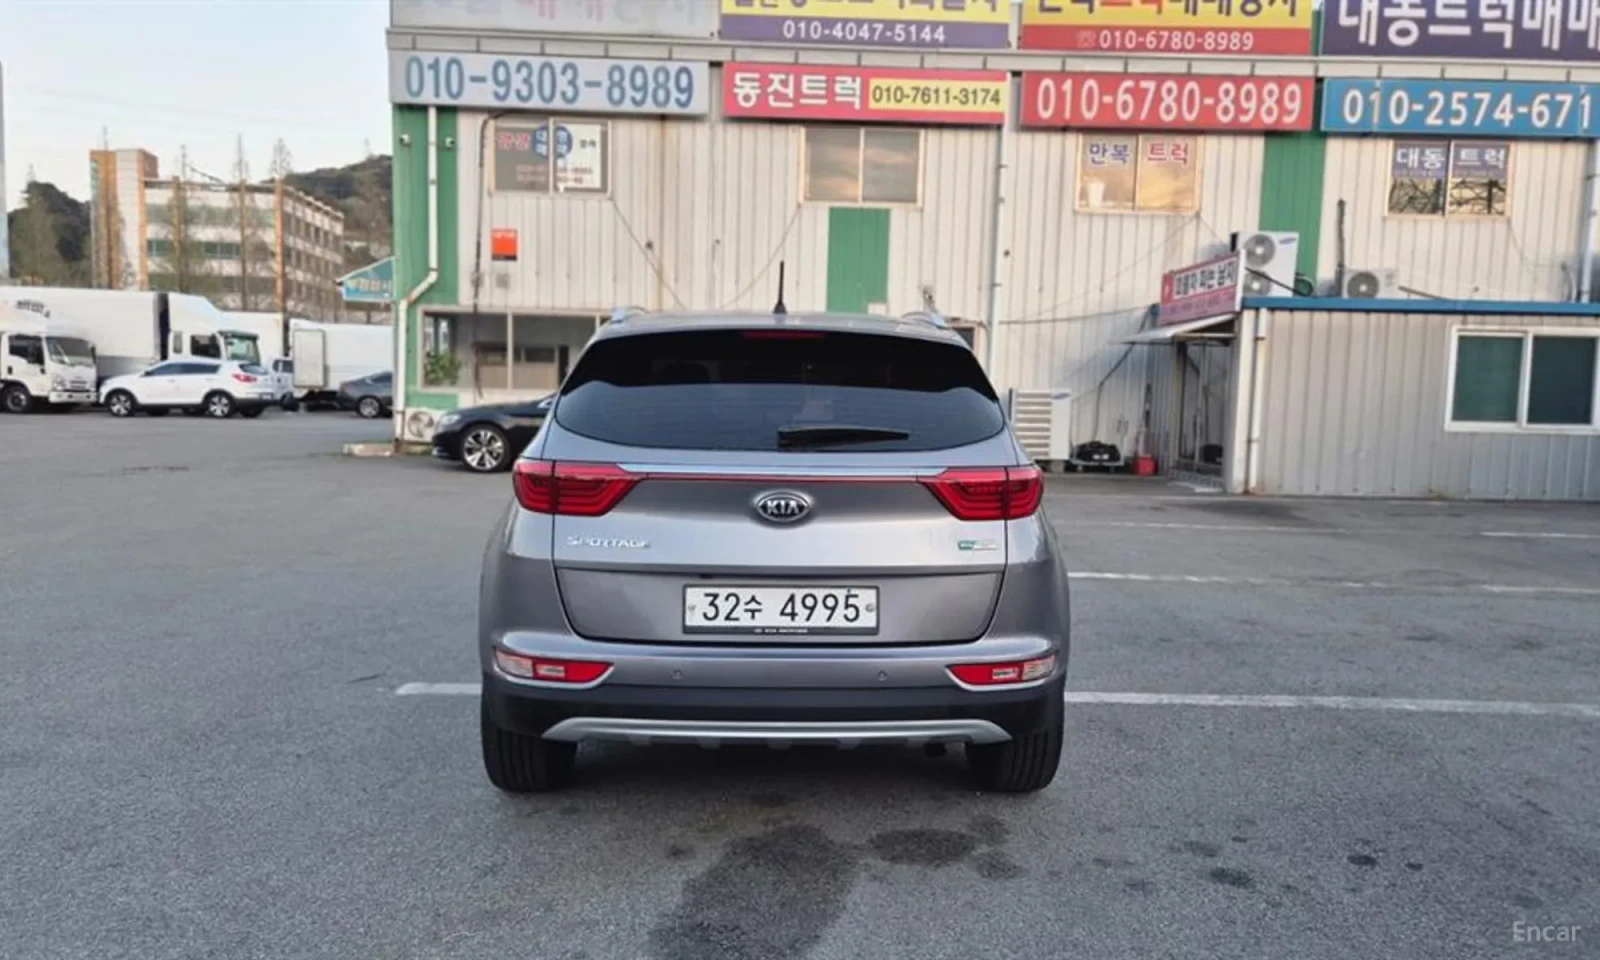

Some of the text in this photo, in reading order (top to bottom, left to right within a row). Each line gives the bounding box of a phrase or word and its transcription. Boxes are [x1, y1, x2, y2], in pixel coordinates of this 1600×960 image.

[783, 19, 946, 43] 010-4047-5144
[1099, 29, 1254, 50] 010-6780-8989
[404, 55, 695, 109] 010-9303-8989
[733, 71, 862, 110] 동진트럭
[871, 85, 1001, 106] 010-7611-3174
[1036, 77, 1302, 124] 010-6780-8989
[1343, 88, 1592, 130] 010-2574-671
[1089, 142, 1189, 166] 만복 트럭
[1396, 146, 1506, 169] 대동 트럭
[767, 499, 800, 515] KIA
[702, 591, 861, 623] 32수 4995
